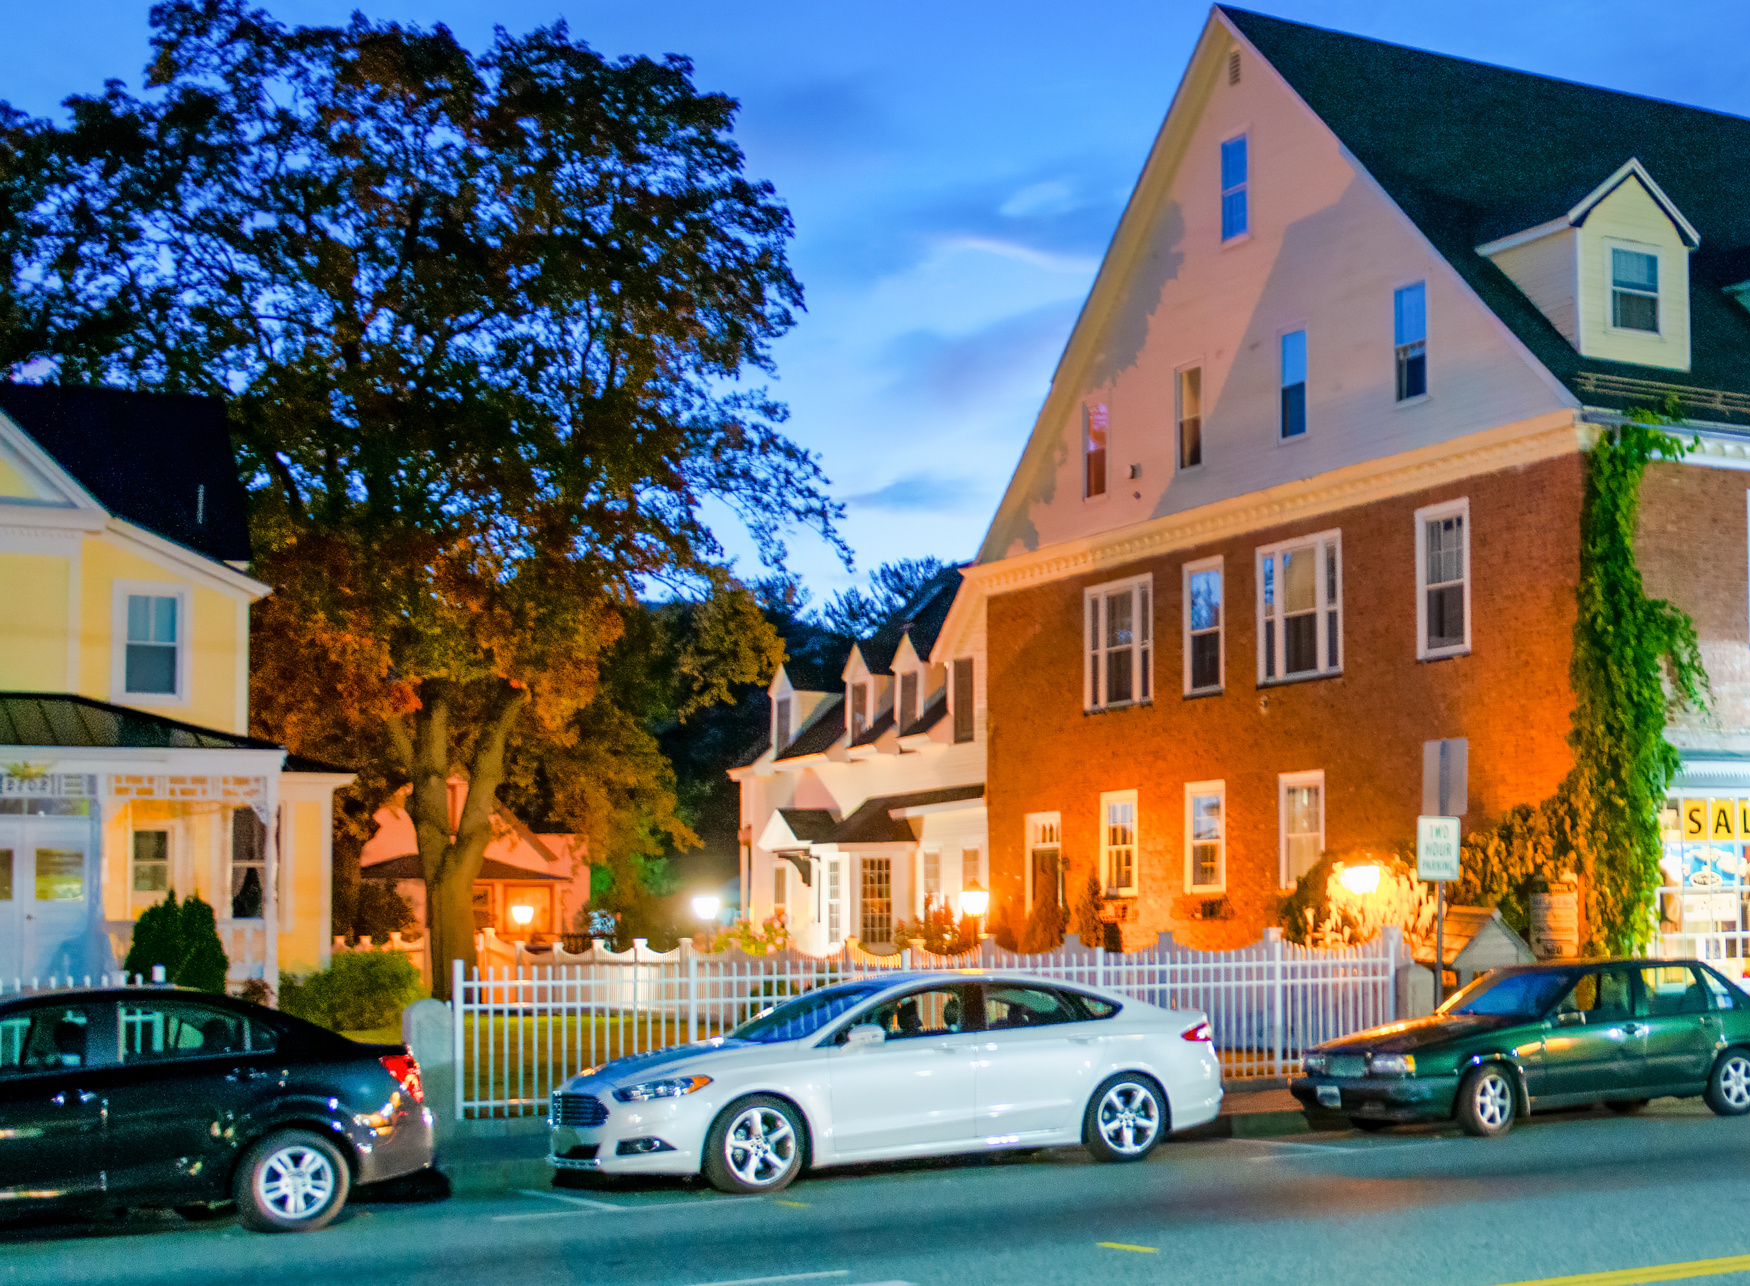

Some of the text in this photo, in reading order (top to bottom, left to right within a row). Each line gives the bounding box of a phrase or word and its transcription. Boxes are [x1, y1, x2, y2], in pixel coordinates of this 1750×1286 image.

[1430, 824, 1449, 838] TWO
[1425, 842, 1452, 856] HOUR
[1422, 860, 1457, 874] PARKING
